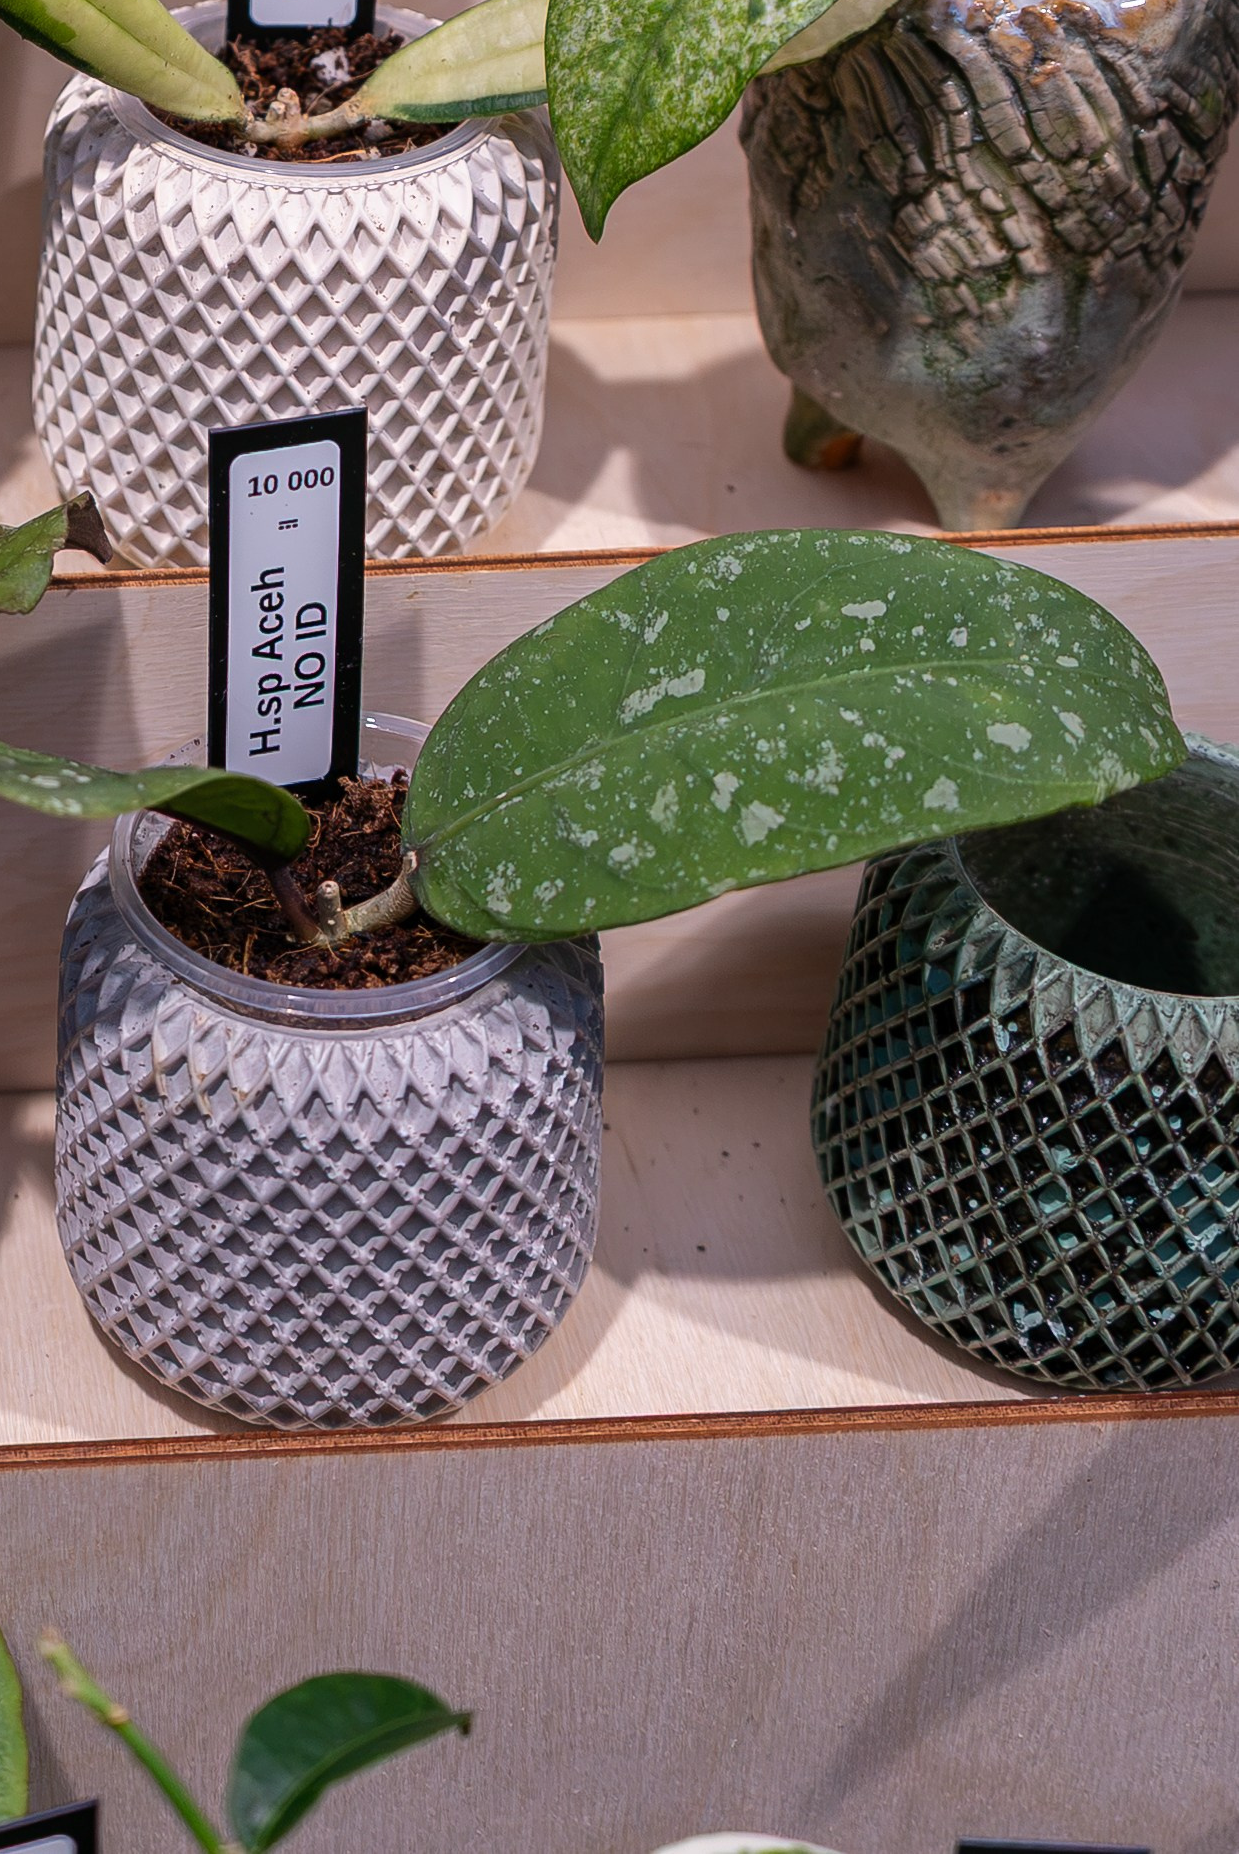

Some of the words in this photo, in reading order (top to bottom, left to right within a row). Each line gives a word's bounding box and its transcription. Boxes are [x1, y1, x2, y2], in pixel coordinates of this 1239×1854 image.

[248, 475, 278, 497] 10
[288, 467, 334, 491] 000
[251, 567, 284, 660] Aceh
[295, 602, 327, 640] ID
[293, 652, 325, 709] NO
[249, 673, 291, 756] H.sp
